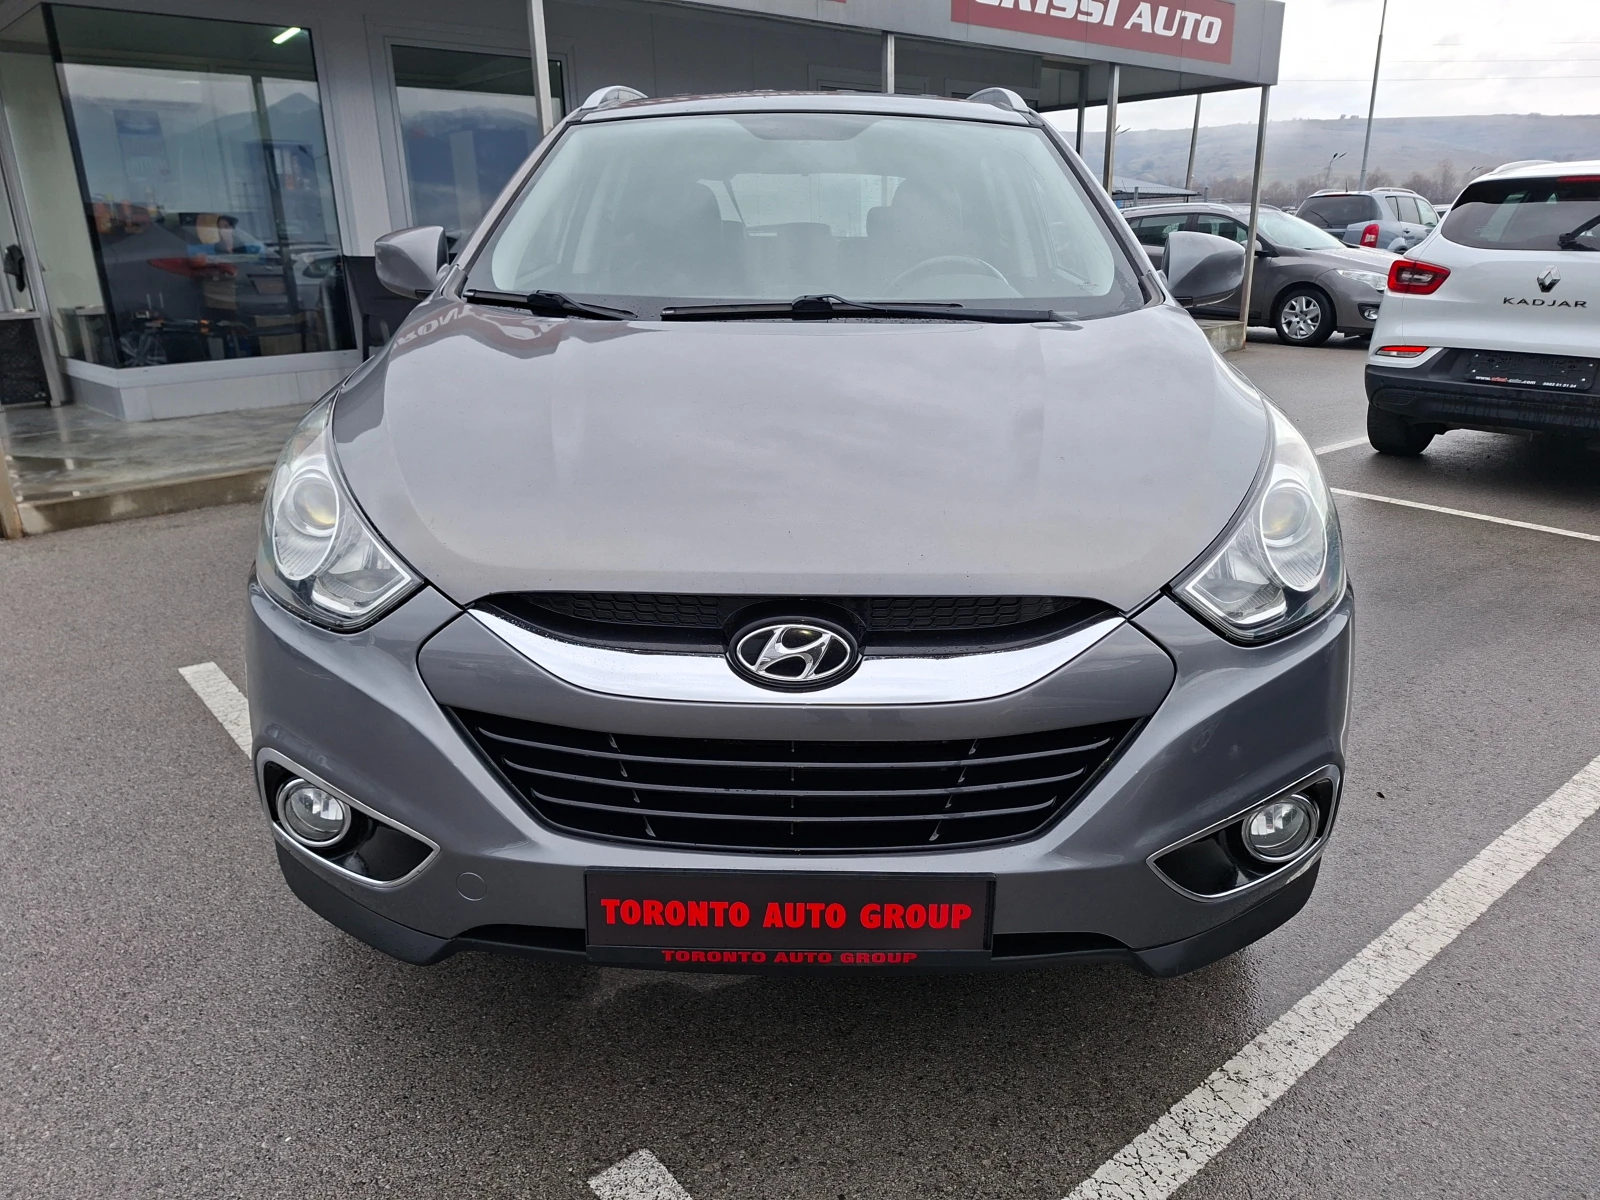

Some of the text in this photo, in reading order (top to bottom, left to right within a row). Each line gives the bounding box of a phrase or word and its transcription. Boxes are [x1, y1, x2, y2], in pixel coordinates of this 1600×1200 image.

[1124, 2, 1222, 44] AUTO
[1503, 297, 1587, 308] KADJAR
[600, 898, 972, 930] TORONTO AUTO GROUP
[661, 950, 918, 965] TORONTO AUTO GROUP
